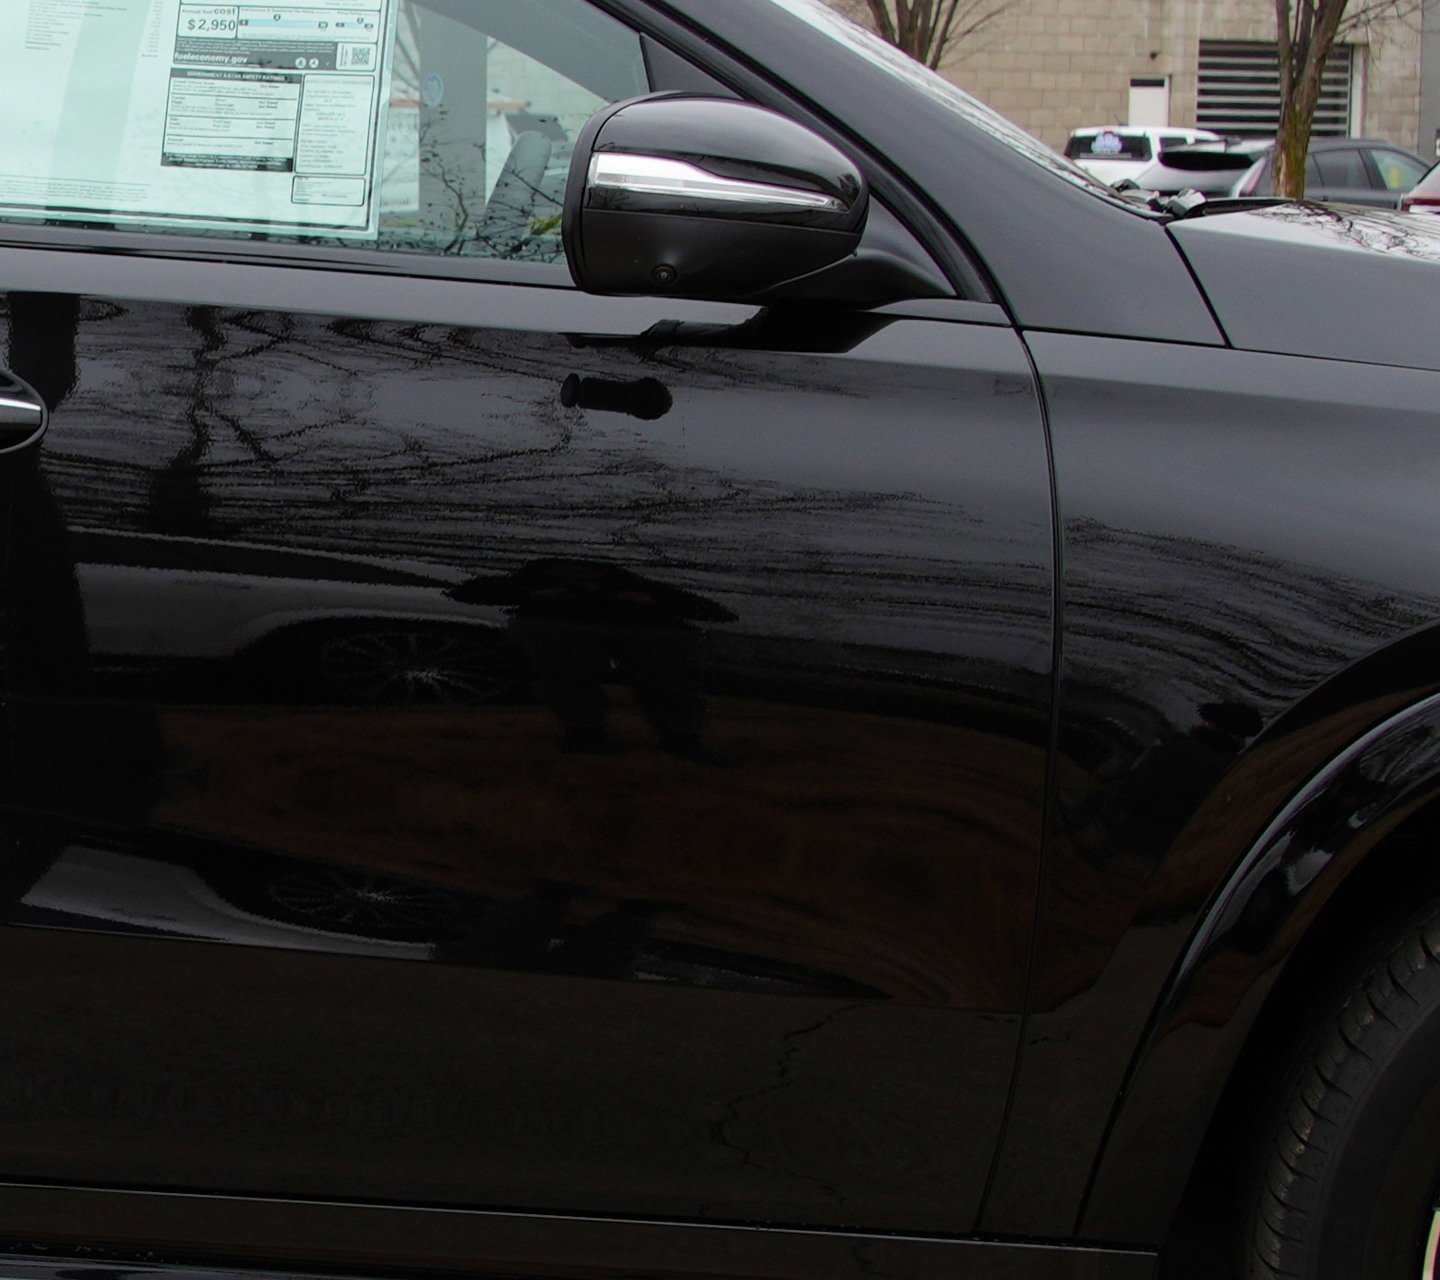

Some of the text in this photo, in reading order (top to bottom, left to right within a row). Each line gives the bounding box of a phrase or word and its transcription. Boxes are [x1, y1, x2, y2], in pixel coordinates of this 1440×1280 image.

[214, 7, 235, 15] cost
[187, 18, 236, 31] $2,950
[174, 52, 248, 64] fueleconomy.gov
